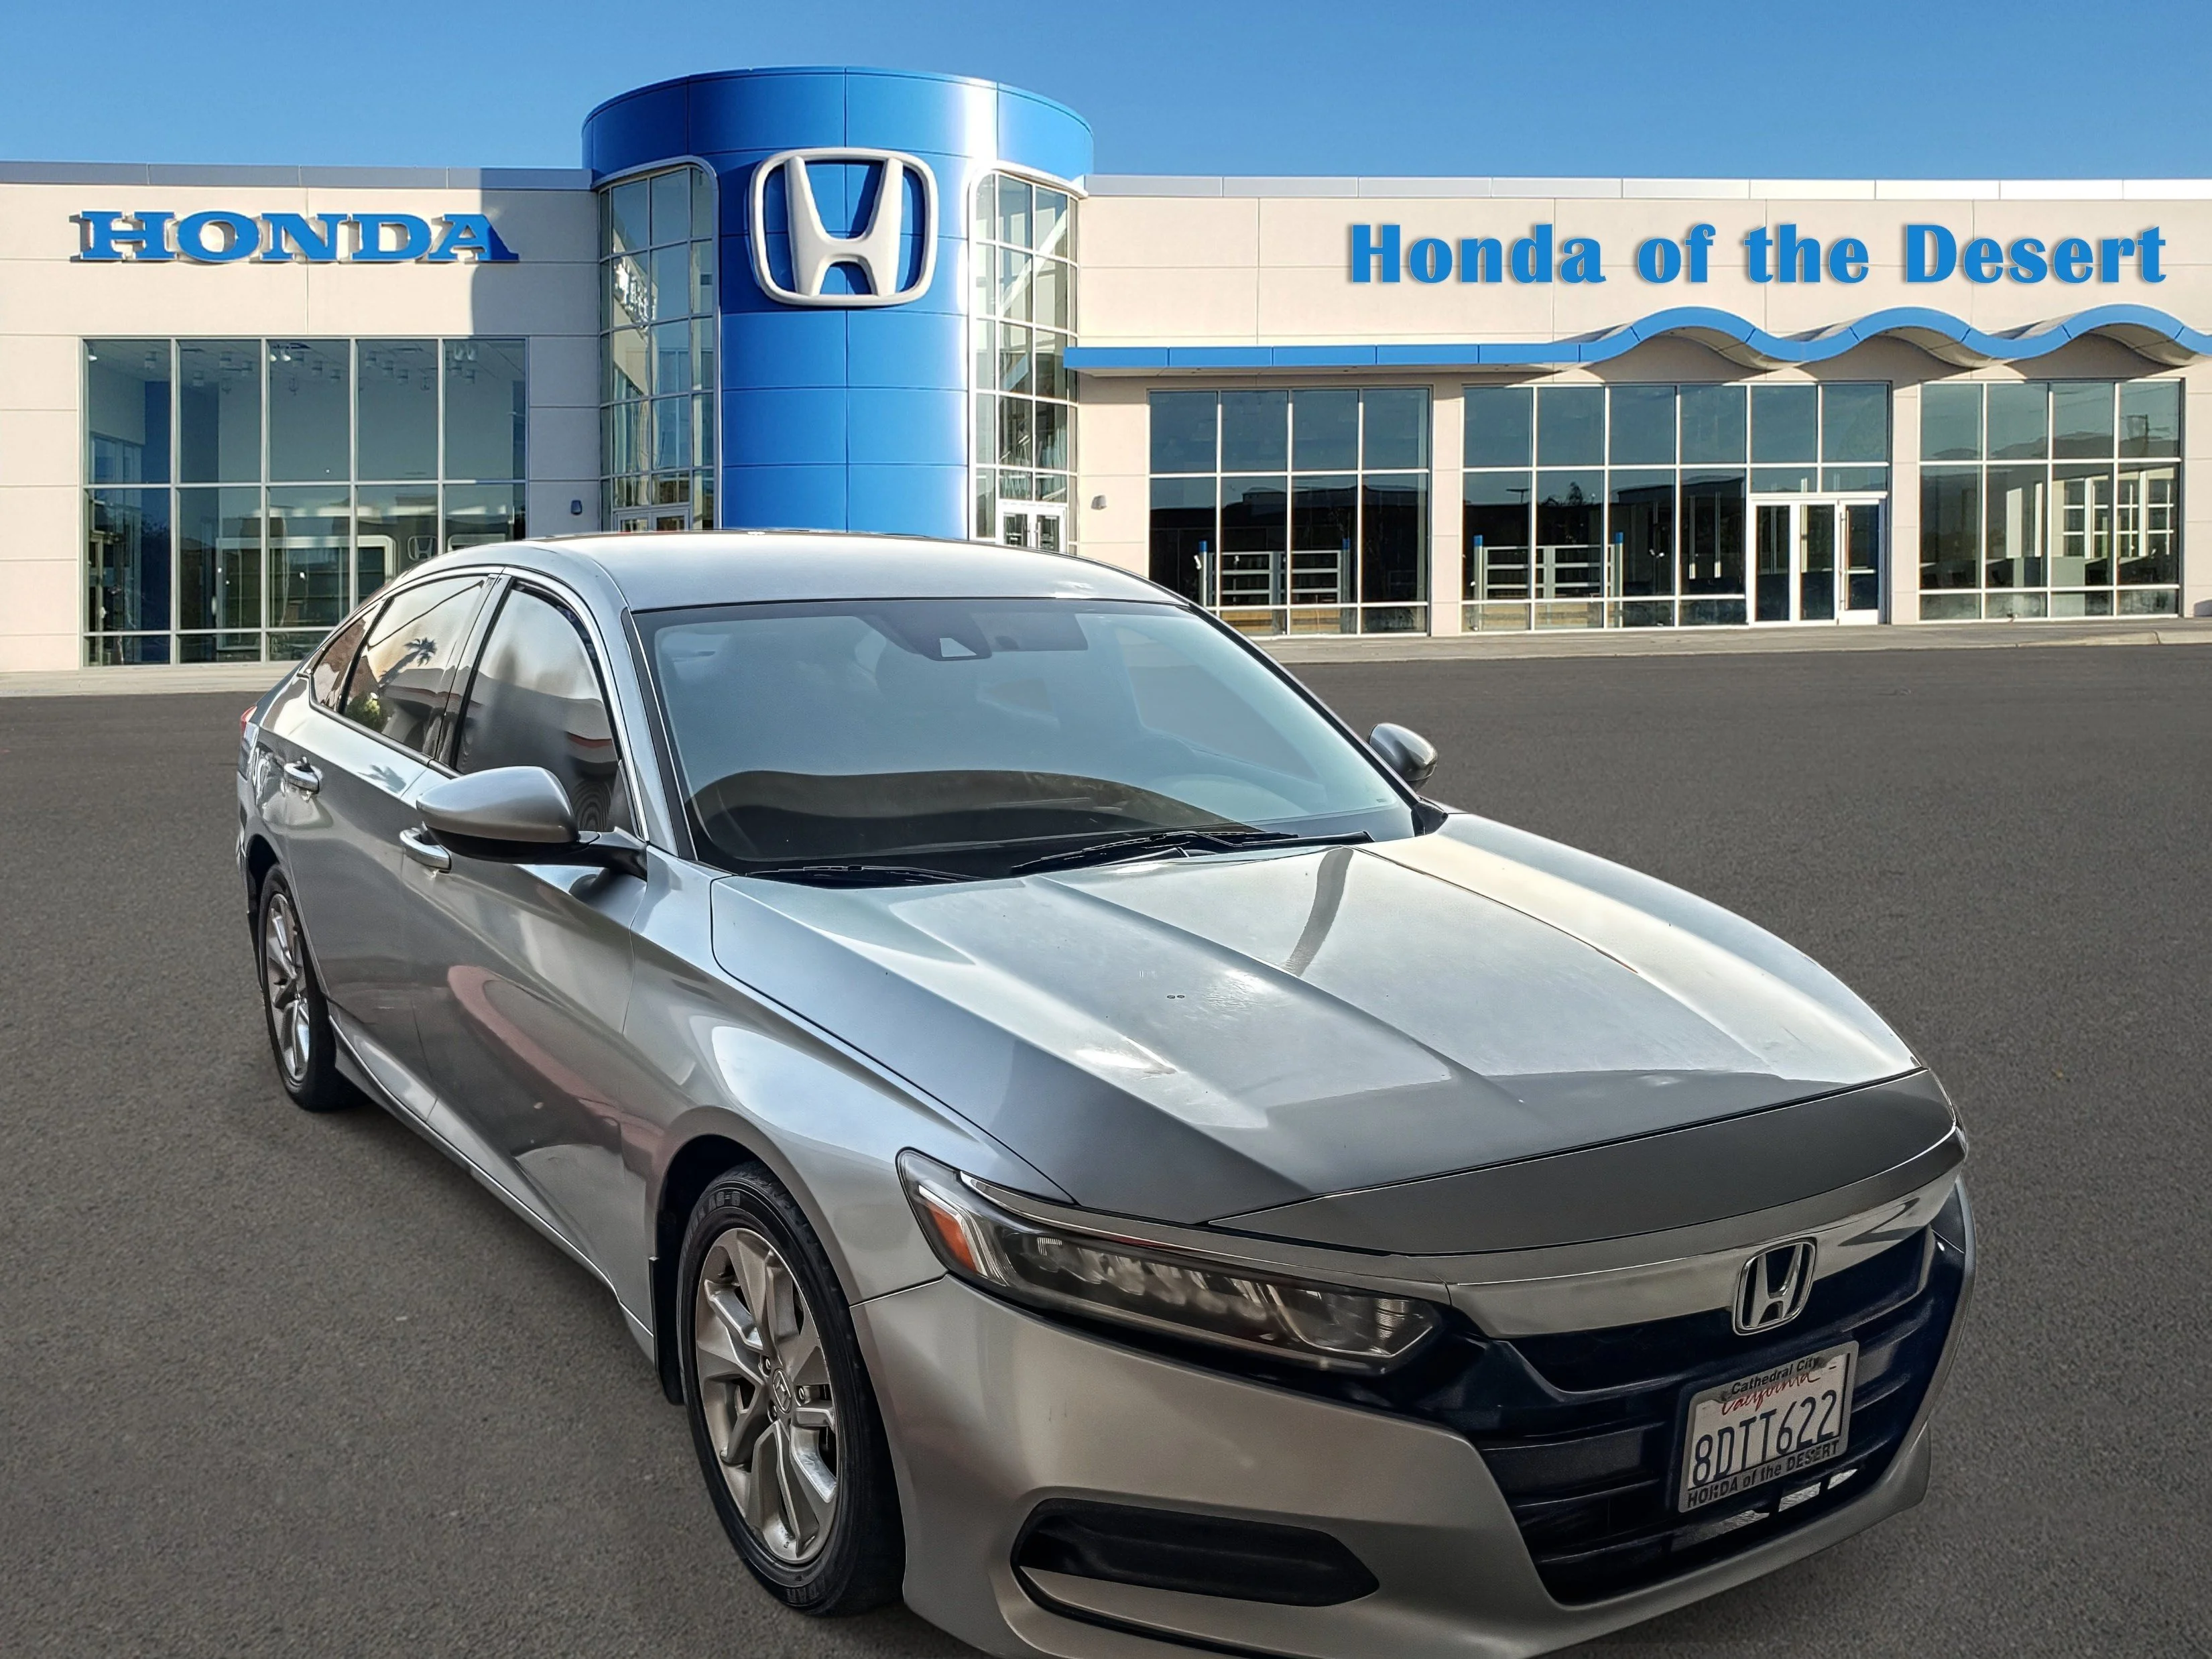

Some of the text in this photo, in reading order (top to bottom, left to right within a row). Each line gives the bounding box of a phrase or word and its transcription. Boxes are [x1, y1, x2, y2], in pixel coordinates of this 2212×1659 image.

[81, 210, 519, 262] HONDA
[1351, 223, 2166, 284] Honda of the Desert
[1731, 1355, 1819, 1395] Cathedral City
[1693, 1389, 1837, 1487] 8DTT622
[1743, 1469, 1757, 1487] of
[1760, 1464, 1782, 1479] the
[1786, 1439, 1839, 1472] DESERT
